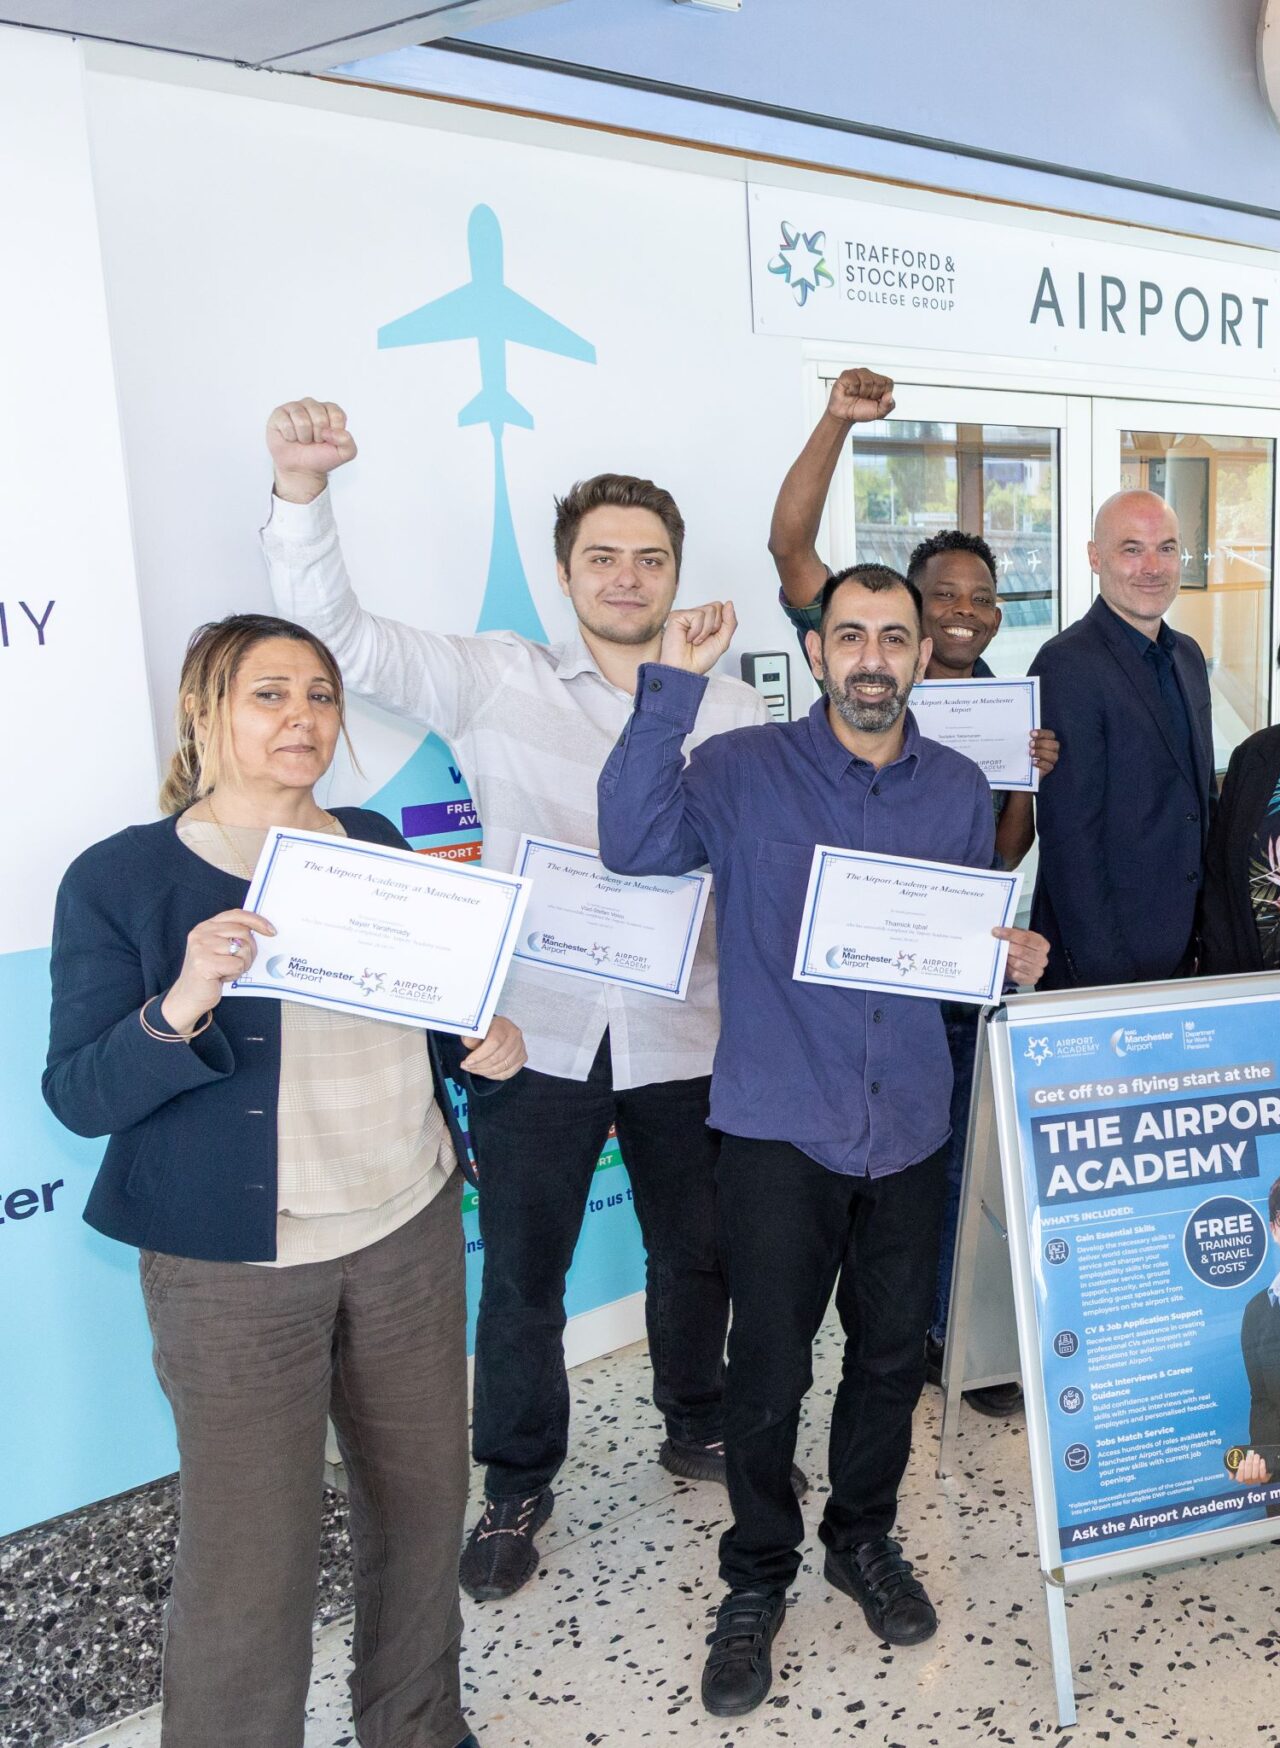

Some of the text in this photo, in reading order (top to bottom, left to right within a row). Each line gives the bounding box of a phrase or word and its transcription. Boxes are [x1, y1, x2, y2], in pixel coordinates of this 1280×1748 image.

[845, 242, 955, 272] TRAFFORD &
[846, 265, 955, 294] STOCKPORT
[847, 289, 955, 311] COLLEGE GROUP
[1030, 267, 1268, 348] AIRPORT
[0, 600, 56, 647] Y
[304, 860, 480, 905] The Airport Academy at Manchester
[547, 863, 674, 895] The Airport Academy Manchester
[595, 883, 622, 894] Airport
[846, 873, 861, 881] The
[863, 876, 892, 885] Airport
[893, 880, 928, 890] Academy
[940, 885, 984, 897] Manchester
[372, 887, 408, 903] Airport
[899, 889, 928, 898] Airport
[542, 937, 587, 953] Manchester
[841, 960, 869, 969] Airport
[842, 952, 892, 964] Manchester
[923, 959, 958, 967] AIRPORT
[286, 969, 323, 983] Airport
[288, 962, 354, 981] Manchester
[921, 965, 961, 975] ACADEMY
[391, 987, 443, 1001] ACADEMY
[394, 979, 439, 992] AIRPORT
[1056, 1036, 1094, 1047] AIRPORT
[1124, 1032, 1173, 1044] Manchester
[1126, 1042, 1153, 1052] Airport
[1056, 1043, 1100, 1054] ACADEMY
[1035, 1065, 1271, 1104] Get off to a flying start at the
[1040, 1116, 1123, 1154] THE
[1046, 1141, 1248, 1197] ACADEMY
[0, 1179, 64, 1224] er
[589, 1193, 623, 1212] to us
[1041, 1207, 1134, 1227] WHAT'S INCLUDED:
[1096, 1229, 1132, 1240] Essential
[1134, 1224, 1156, 1233] Skills
[1194, 1214, 1254, 1240] FREE
[1199, 1235, 1252, 1251] TRAINING
[1201, 1248, 1253, 1264] & TRAVEL
[1123, 1315, 1170, 1329] Application
[1171, 1308, 1203, 1321] Support
[1090, 1380, 1113, 1390] Mock
[1115, 1372, 1158, 1386] Interviews
[1167, 1366, 1193, 1376] Career
[1092, 1388, 1130, 1401] Guidance
[1096, 1426, 1174, 1447] Jobs Match Service
[1098, 1449, 1120, 1458] Access
[1122, 1441, 1153, 1453] hundreds
[1163, 1437, 1178, 1446] roles
[1180, 1432, 1208, 1442] available
[1099, 1455, 1137, 1467] Manchester
[1165, 1442, 1189, 1454] directly
[1191, 1438, 1221, 1449] matching
[1099, 1469, 1114, 1478] your
[1132, 1461, 1147, 1470] skills
[1150, 1458, 1164, 1466] with
[1166, 1453, 1189, 1464] current
[1191, 1451, 1201, 1460] job
[1100, 1475, 1136, 1487] openings.
[1072, 1526, 1098, 1542] Ask
[1102, 1519, 1125, 1536] the
[1130, 1509, 1179, 1530] Airport
[1182, 1494, 1244, 1519] Academy
[1248, 1491, 1267, 1504] for
